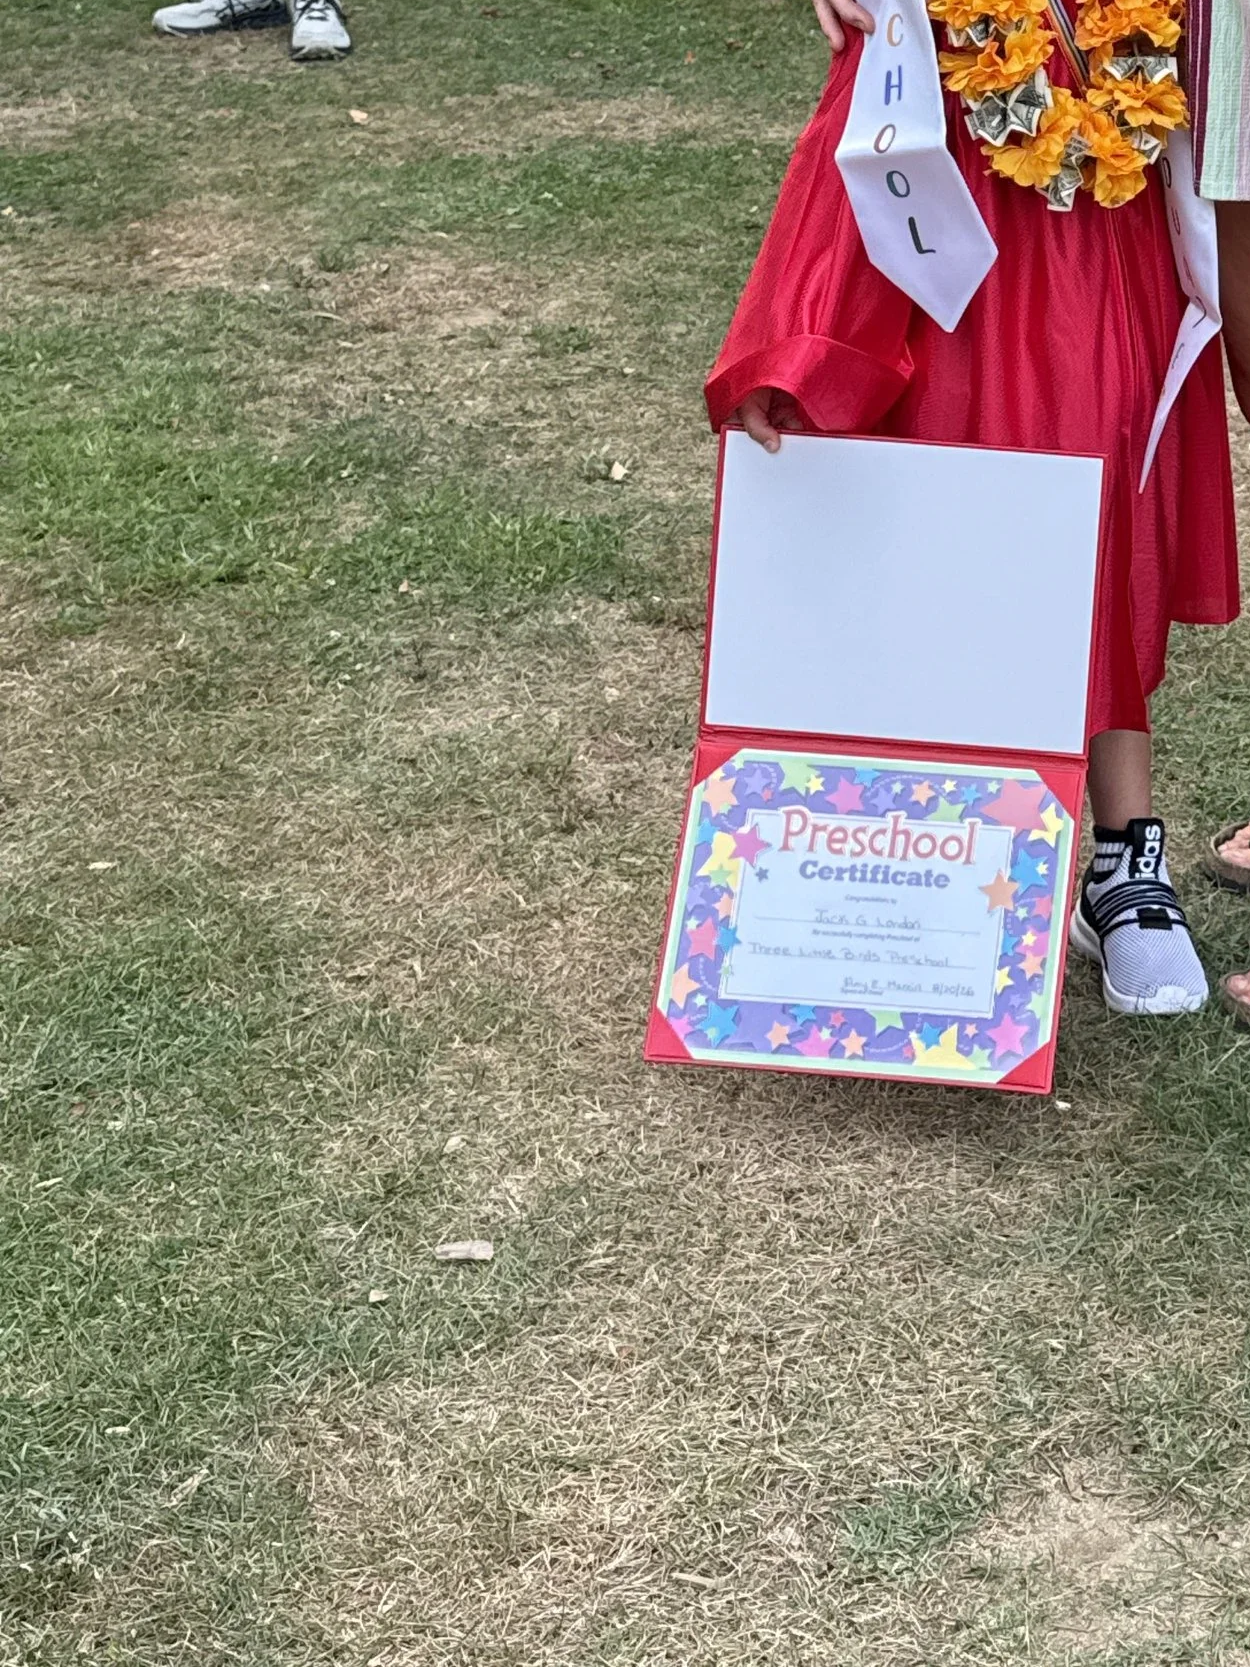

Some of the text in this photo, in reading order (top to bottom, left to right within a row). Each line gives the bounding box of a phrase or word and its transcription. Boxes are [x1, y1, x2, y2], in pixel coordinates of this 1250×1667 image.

[777, 808, 980, 866] Preschool
[1134, 824, 1162, 880] idas
[799, 859, 951, 889] Certificate
